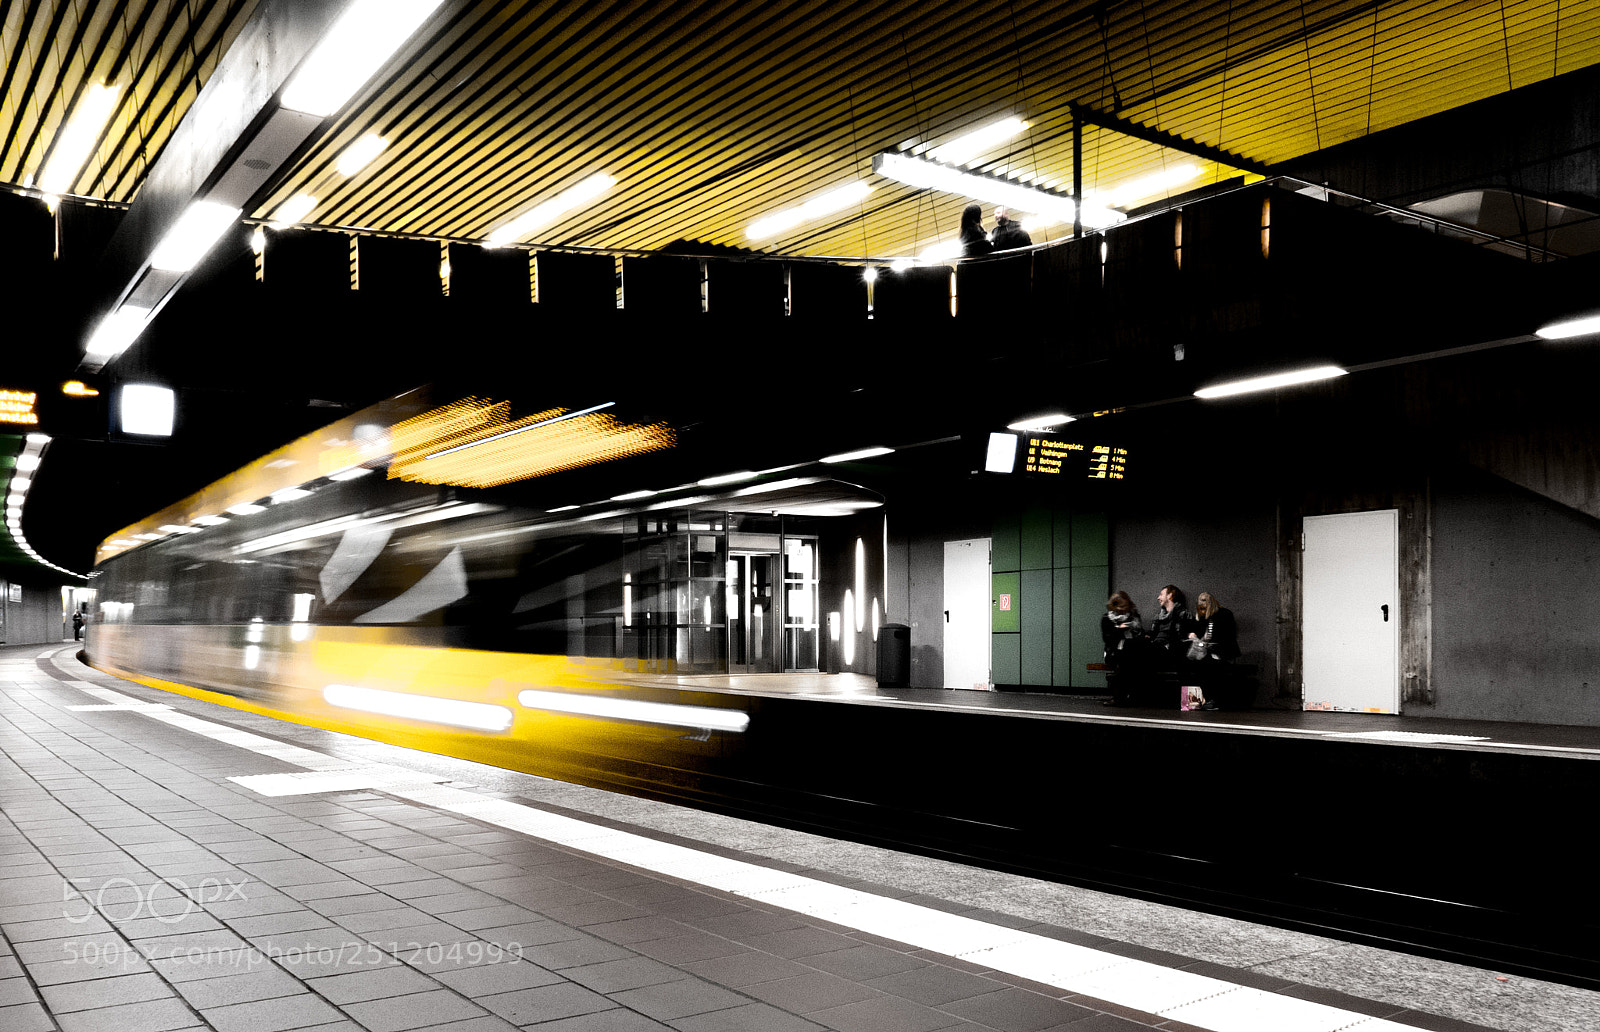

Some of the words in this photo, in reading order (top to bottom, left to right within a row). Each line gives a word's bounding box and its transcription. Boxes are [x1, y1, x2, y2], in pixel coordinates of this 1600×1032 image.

[1042, 440, 1084, 451] Charlottenplatz
[1041, 449, 1068, 458] Vaihingen
[1040, 458, 1062, 467] Botnang
[1038, 466, 1060, 474] Heslach
